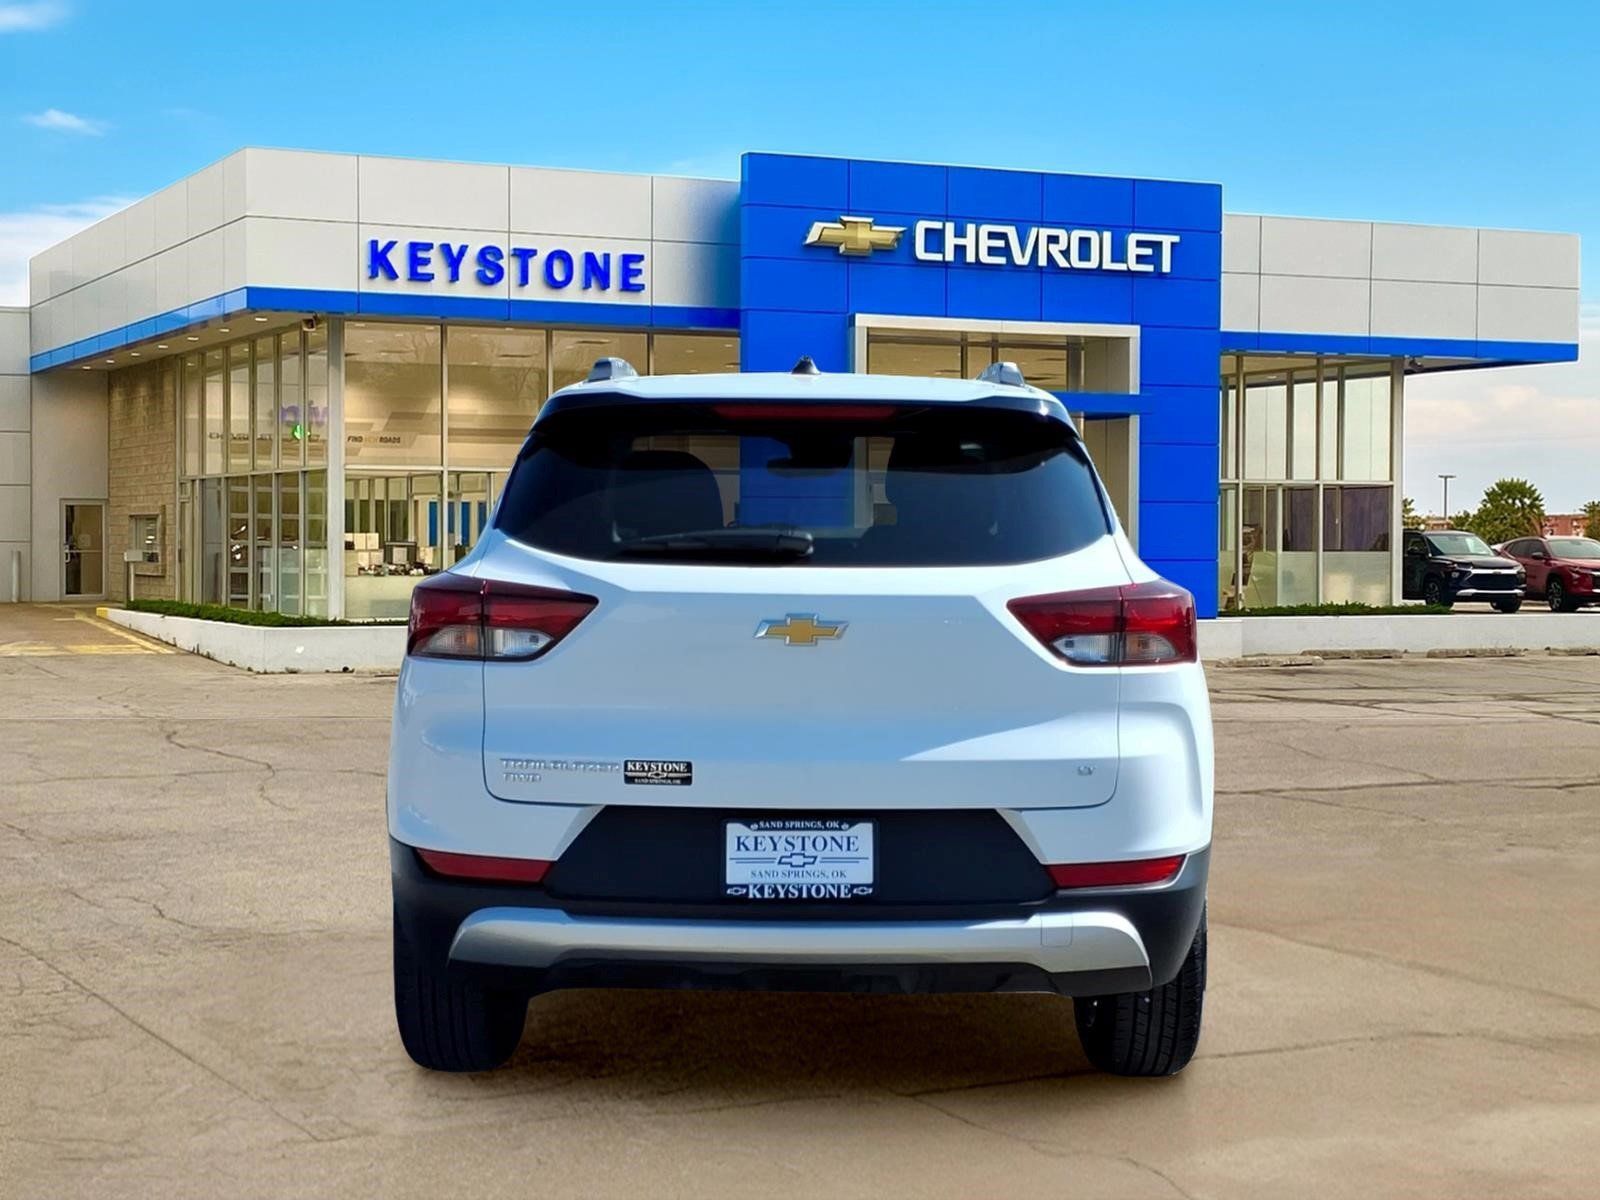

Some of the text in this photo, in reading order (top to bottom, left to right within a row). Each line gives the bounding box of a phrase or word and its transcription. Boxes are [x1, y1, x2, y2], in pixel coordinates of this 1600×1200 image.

[915, 220, 1181, 273] CHEVROLET
[368, 239, 645, 292] KEYSTONE
[627, 761, 688, 772] KEYSTONE
[758, 820, 840, 830] SAND SPRINGS, OK
[736, 835, 860, 852] KEYSTONE
[751, 870, 847, 879] SAND SPRINGS, OK
[748, 884, 852, 899] KEYSTONE
